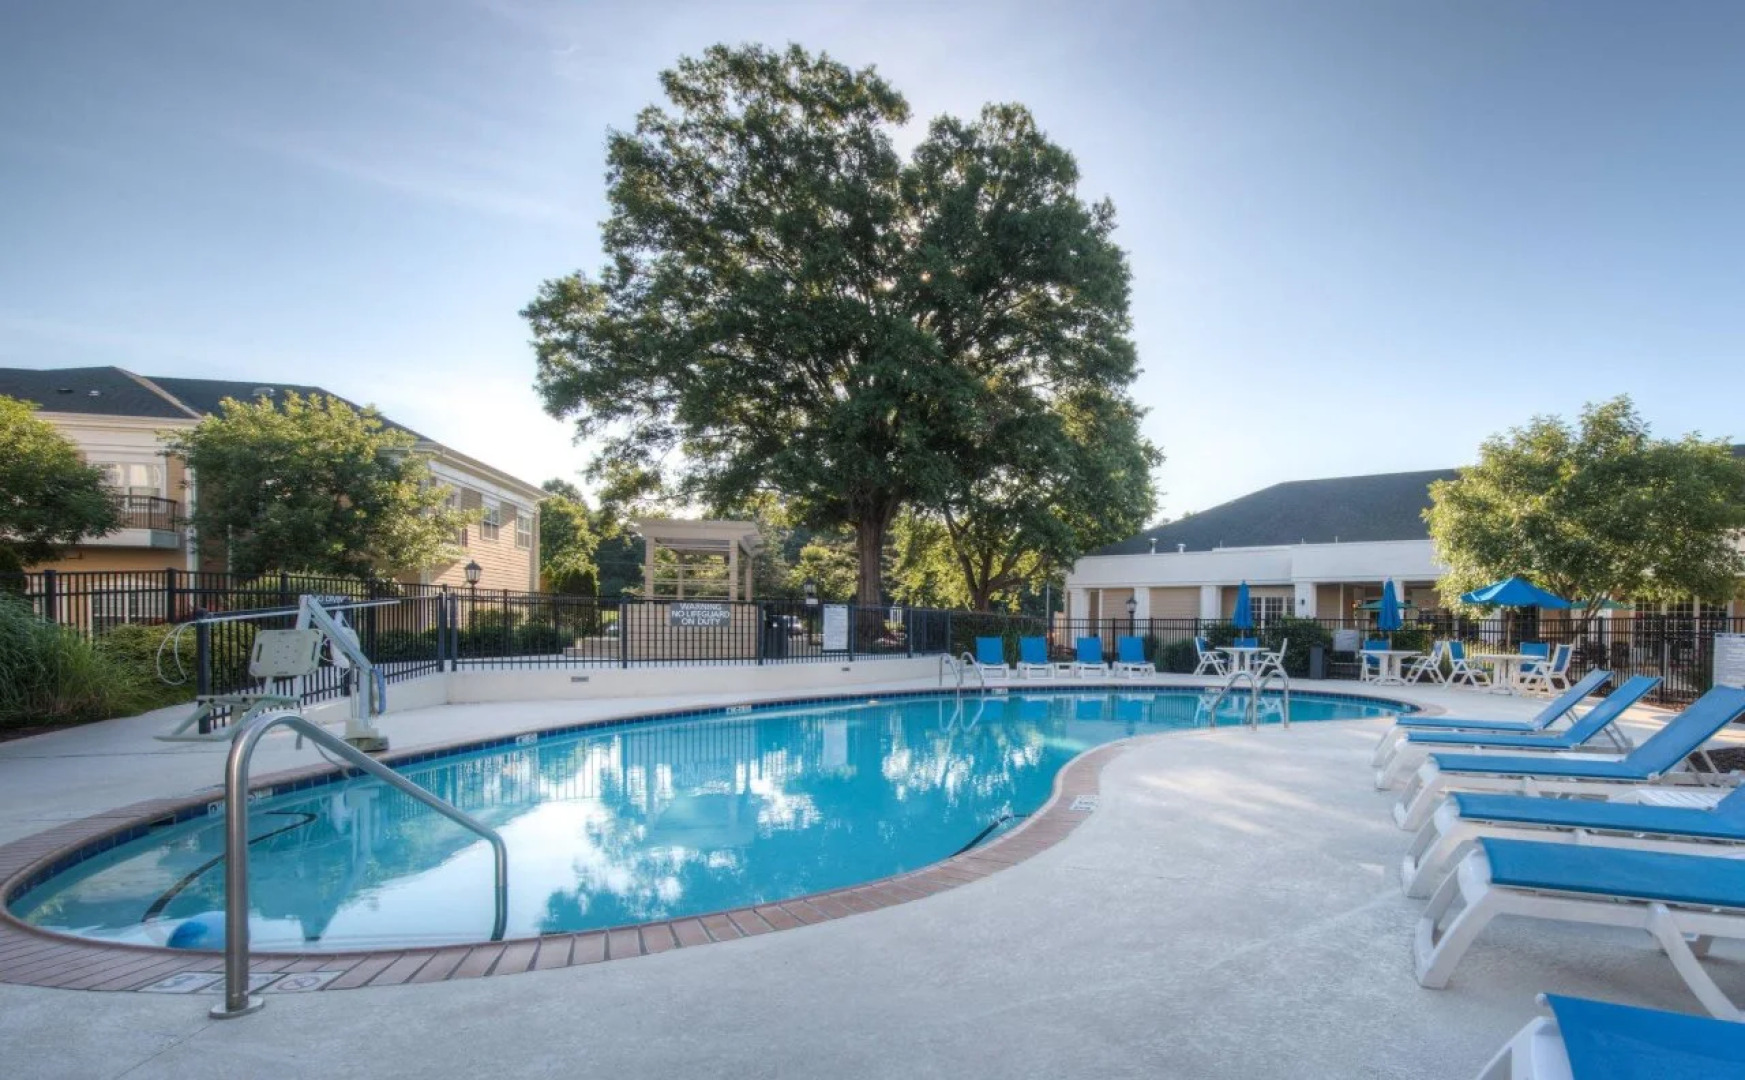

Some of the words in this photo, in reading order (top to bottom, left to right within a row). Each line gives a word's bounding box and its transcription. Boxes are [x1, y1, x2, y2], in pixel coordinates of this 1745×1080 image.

[680, 602, 721, 610] WARNING
[671, 610, 685, 618] NO
[686, 610, 730, 618] LIFEGUARD
[681, 617, 695, 625] ON
